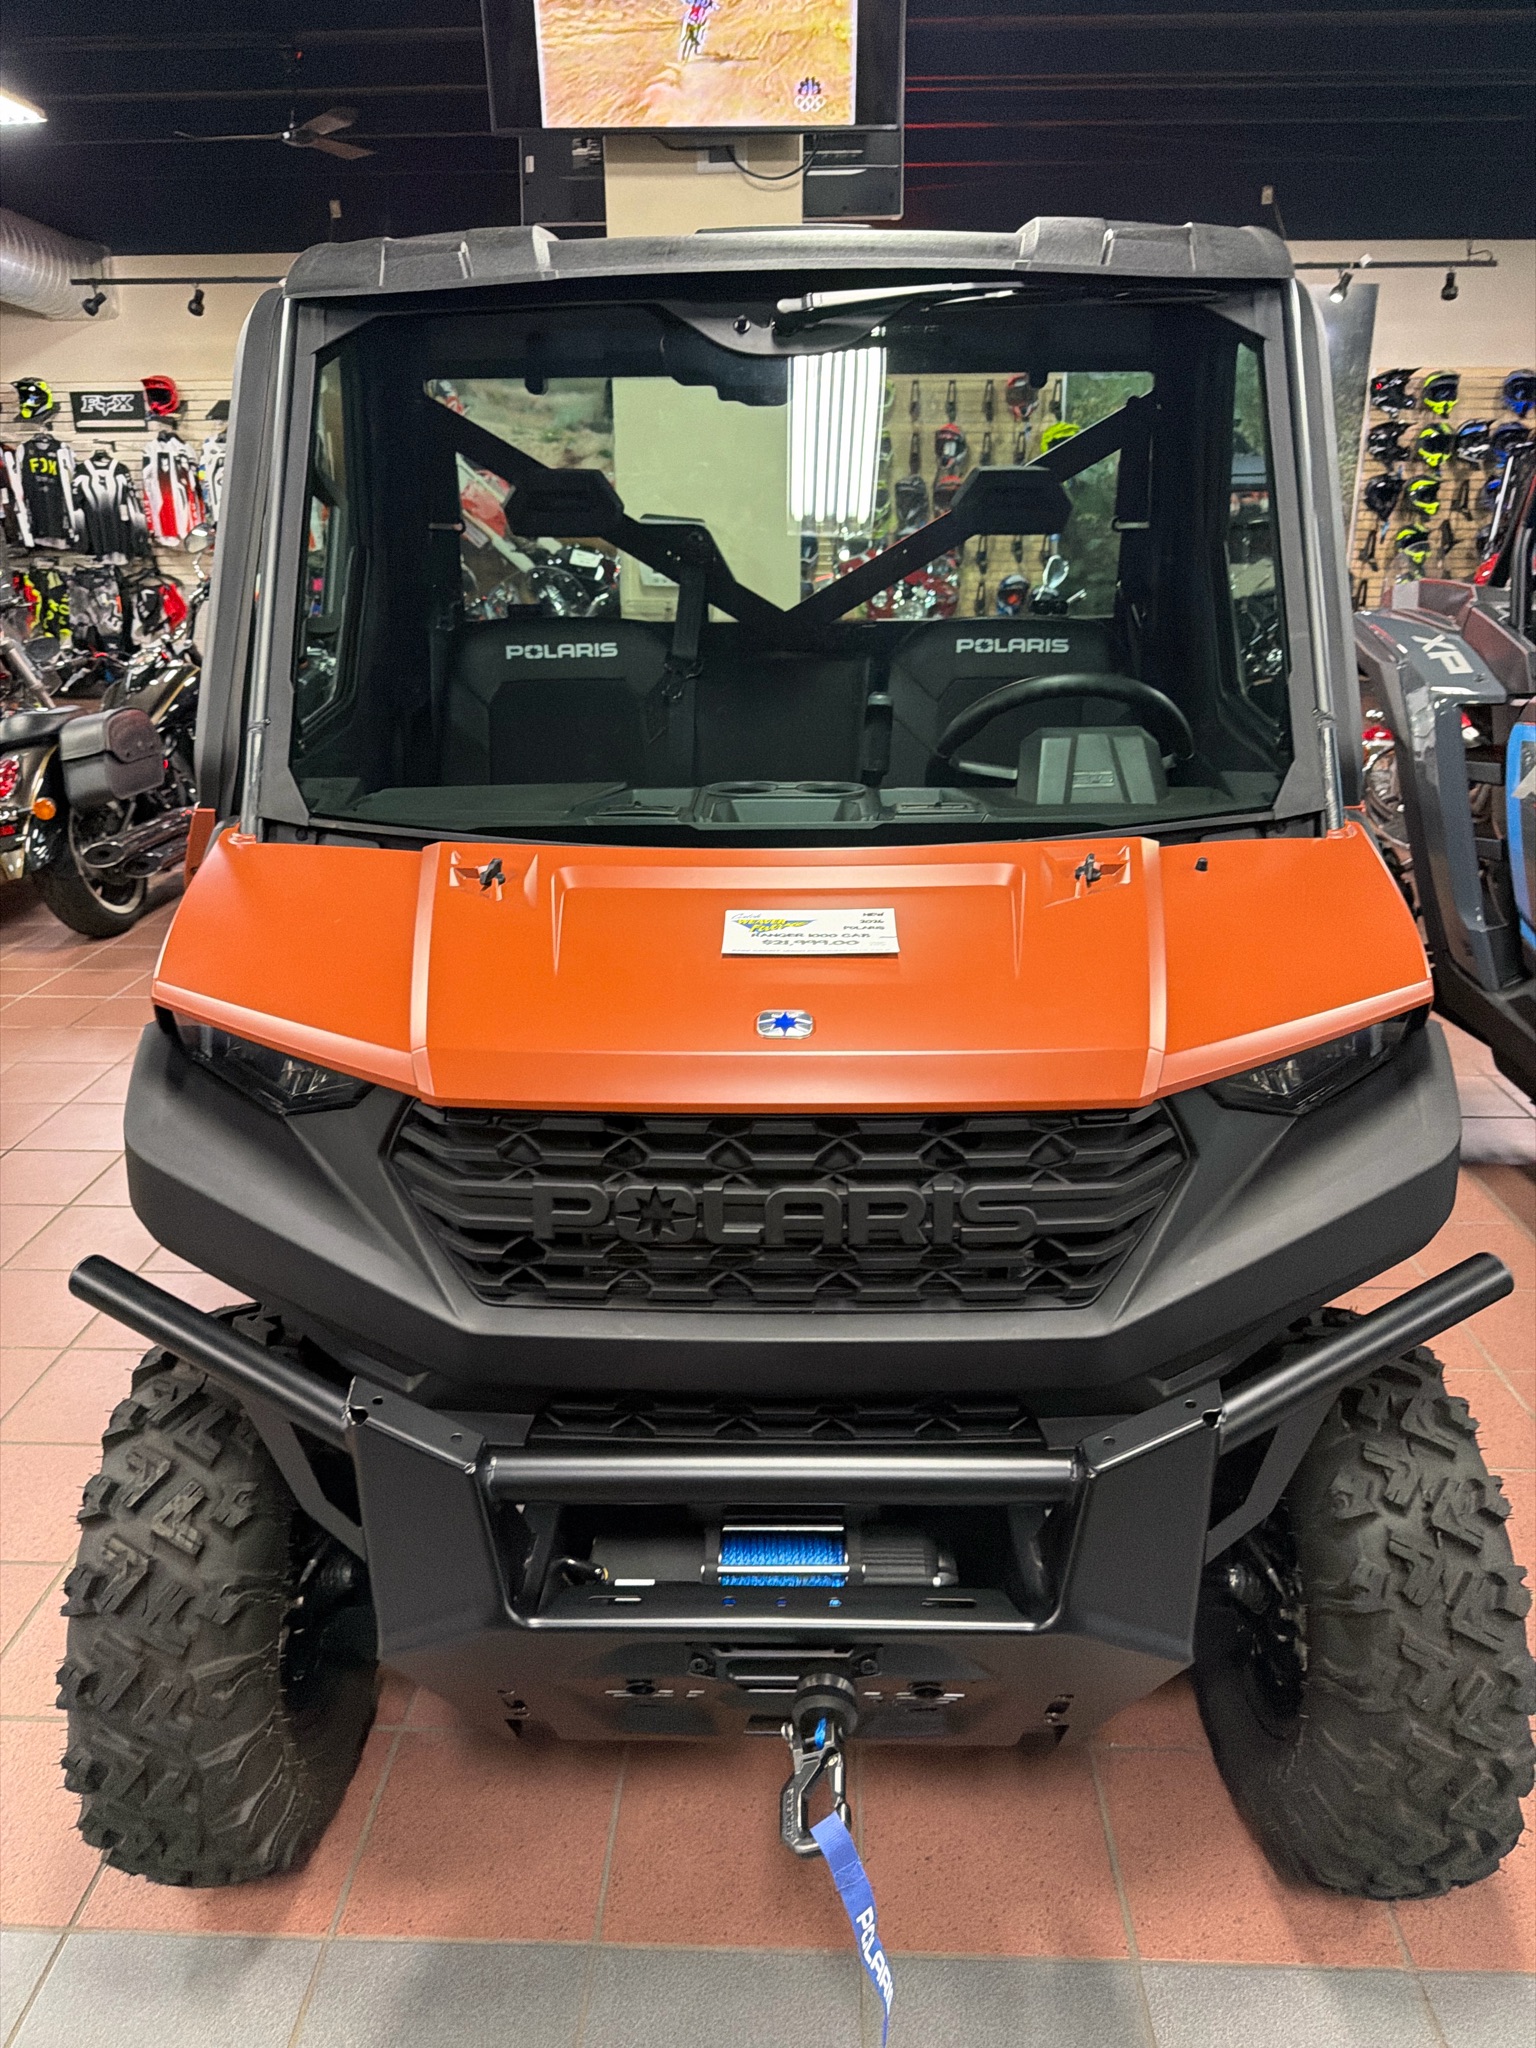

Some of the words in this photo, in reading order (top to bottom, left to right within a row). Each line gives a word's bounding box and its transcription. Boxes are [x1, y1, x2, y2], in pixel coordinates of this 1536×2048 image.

[81, 394, 135, 417] FOX
[29, 457, 57, 475] FOX
[505, 642, 618, 660] POLARIS
[955, 638, 1070, 653] POLARIS
[1411, 634, 1474, 674] XP
[532, 1182, 1039, 1245] POLARIS
